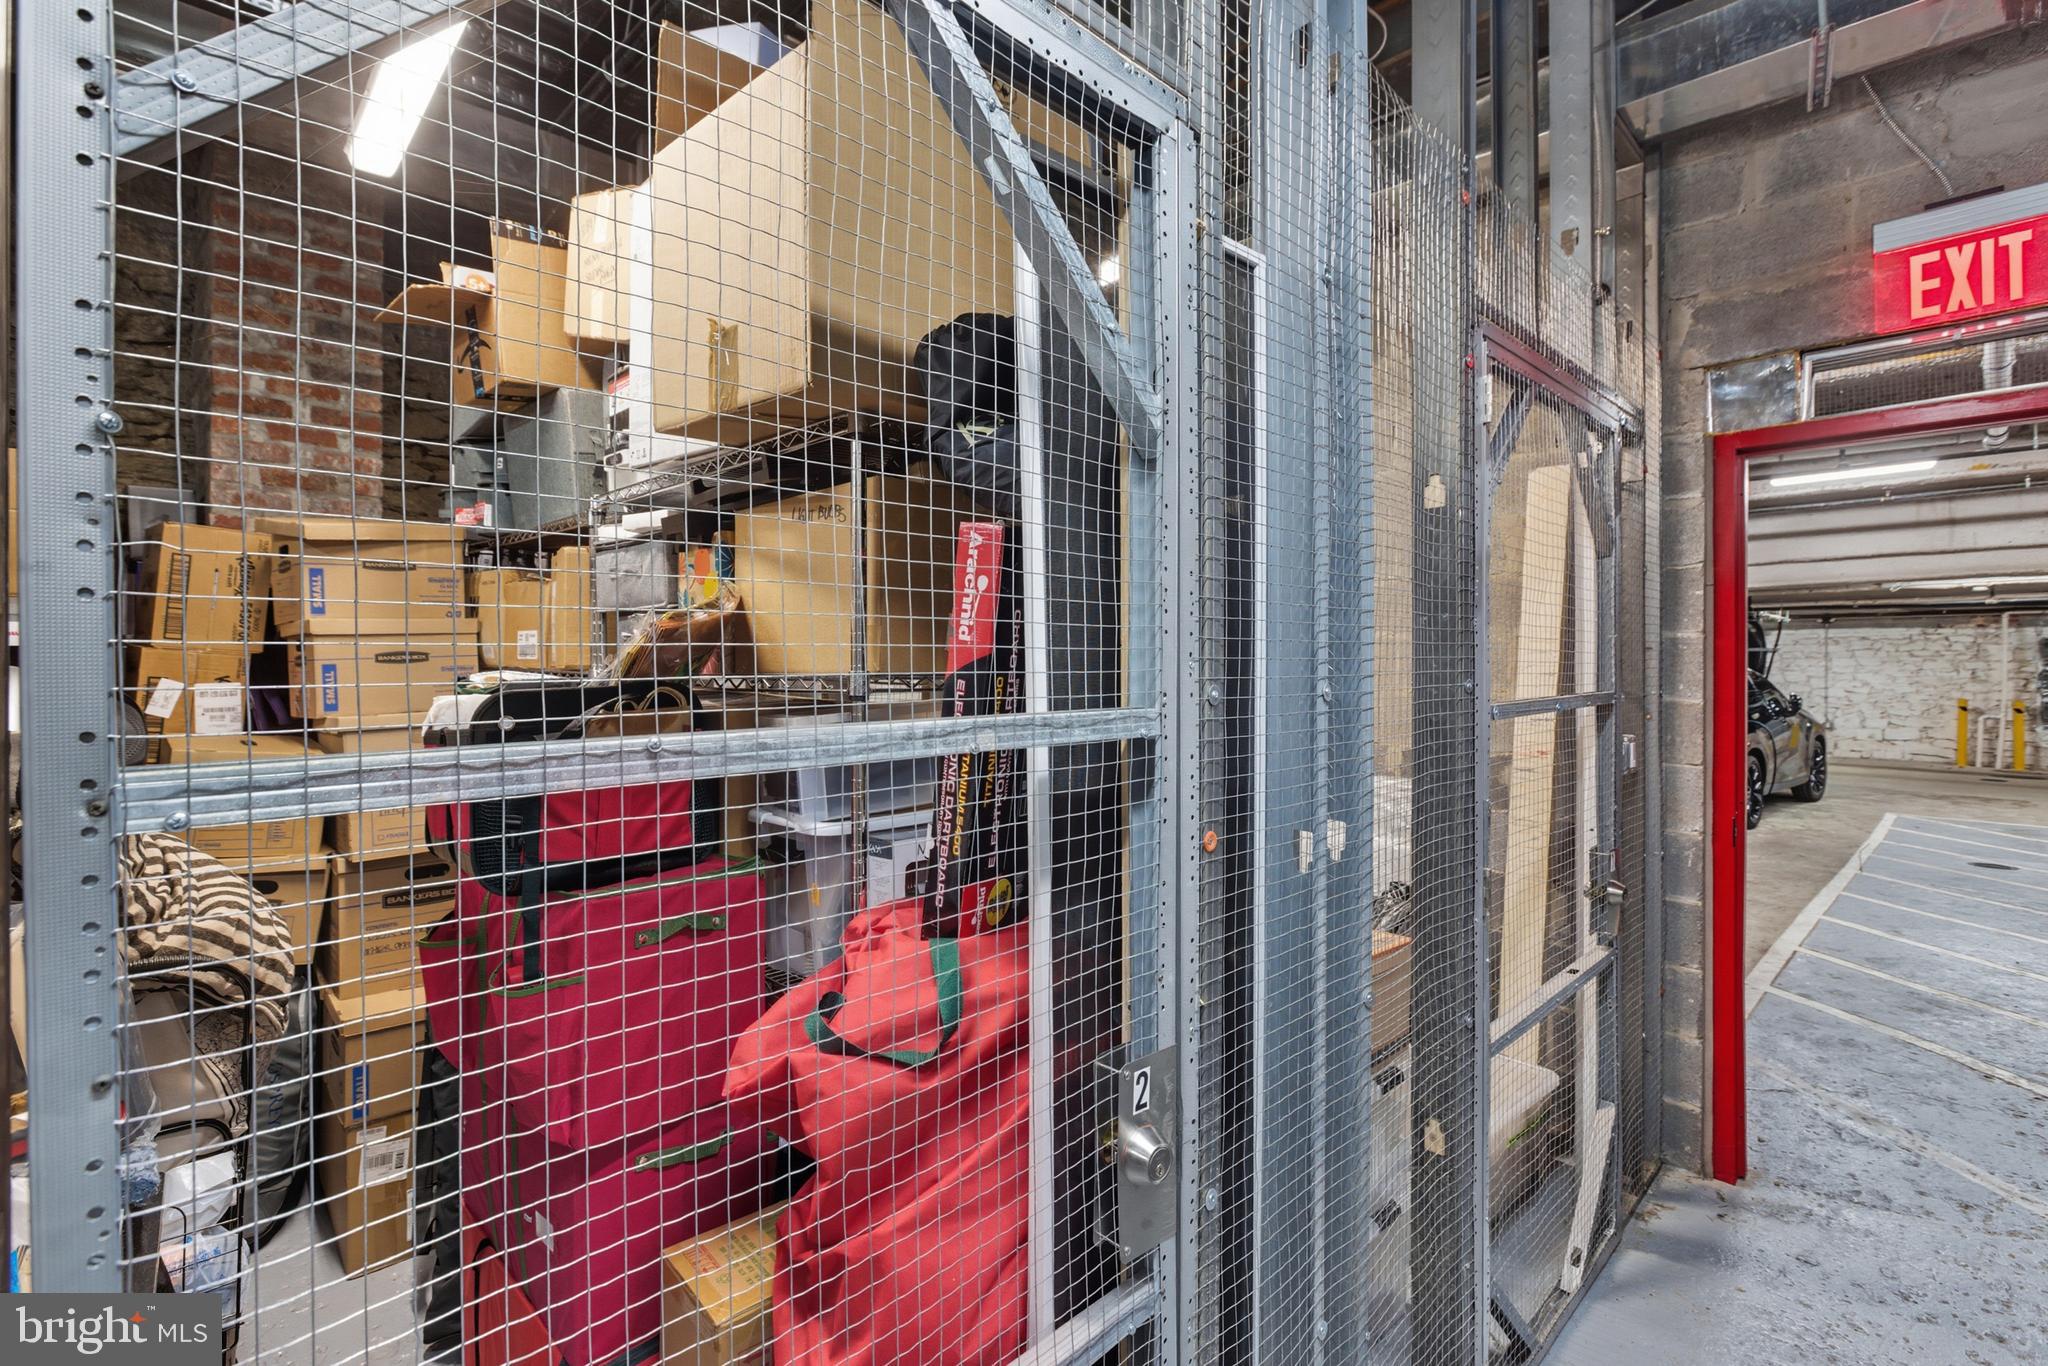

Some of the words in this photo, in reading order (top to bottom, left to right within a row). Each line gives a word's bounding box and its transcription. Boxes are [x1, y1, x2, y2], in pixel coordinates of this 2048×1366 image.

[1909, 229, 2034, 321] EXIT
[312, 574, 323, 609] SMALL
[958, 529, 983, 642] Arachnid
[325, 671, 336, 705] SMALL
[935, 793, 955, 908] DARTBOARD
[1135, 1070, 1149, 1112] 2
